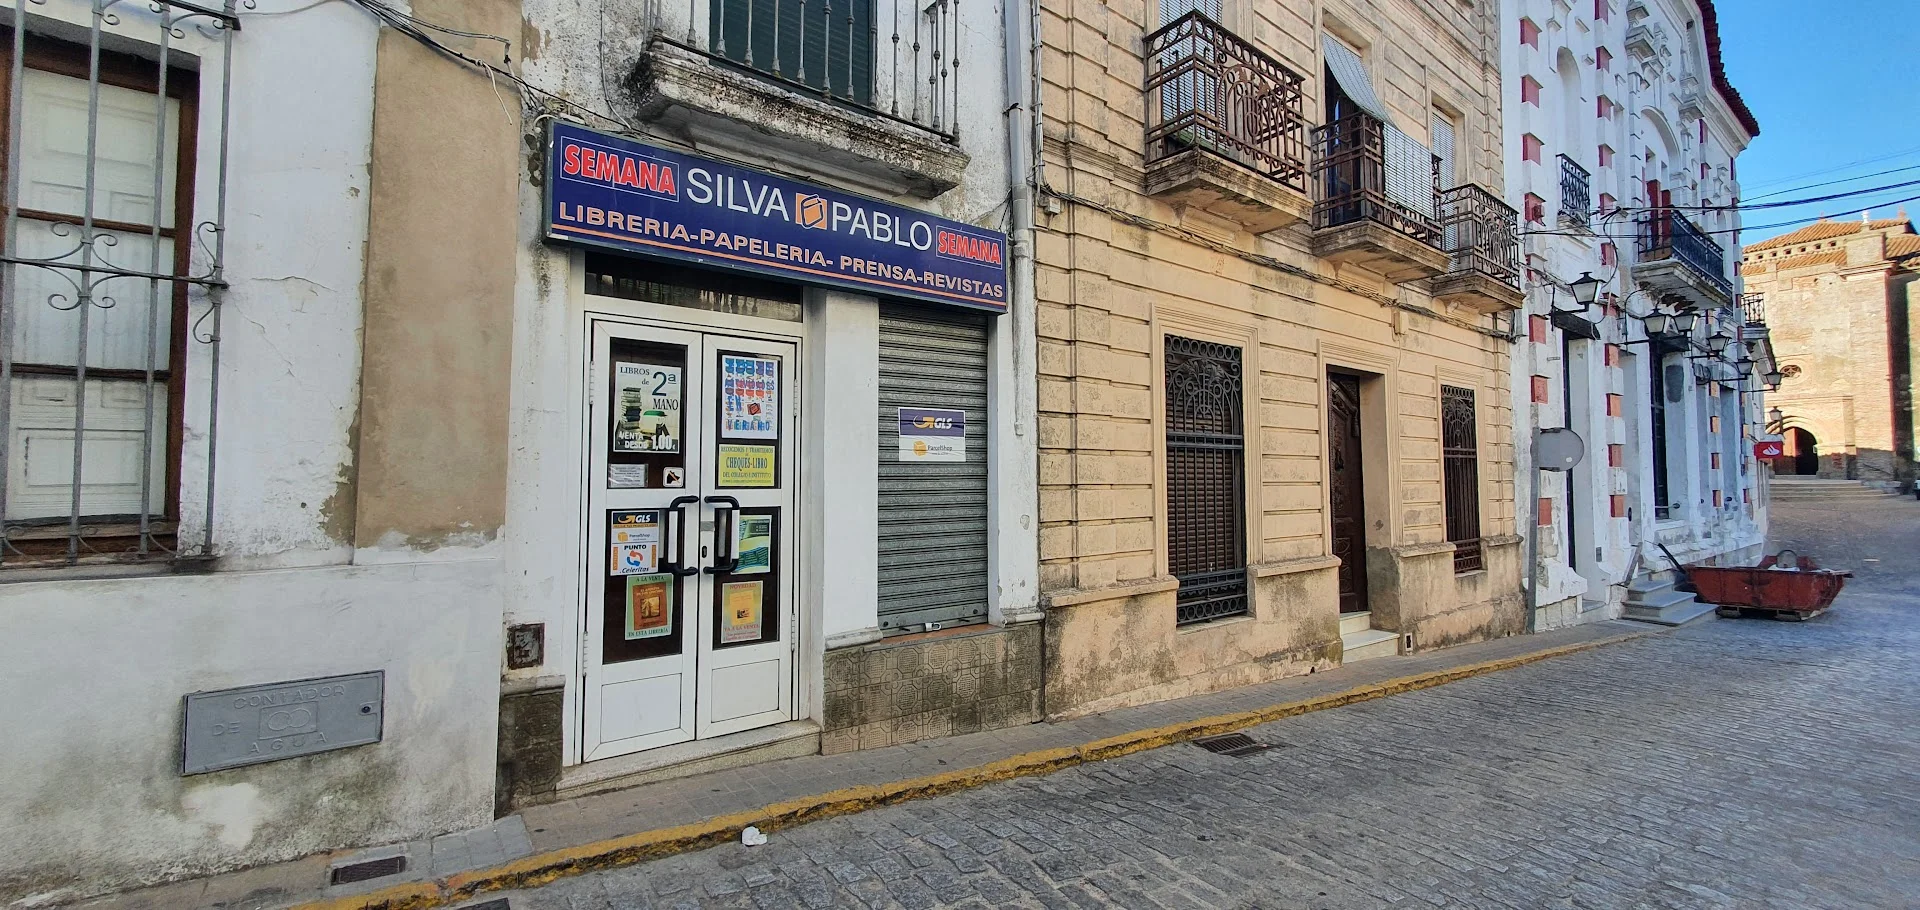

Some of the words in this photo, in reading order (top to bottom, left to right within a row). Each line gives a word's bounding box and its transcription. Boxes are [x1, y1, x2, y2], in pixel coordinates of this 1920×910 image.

[563, 143, 677, 196] SEMANA
[686, 166, 790, 222] SILVA
[831, 201, 933, 251] PABLO
[938, 230, 1002, 265] SEMANA
[620, 366, 650, 376] LIBROS
[652, 398, 679, 410] MANO
[934, 417, 953, 429] GLS
[618, 430, 644, 441] VENTA
[725, 456, 769, 472] CHEQUES-LIBRO
[635, 514, 651, 523] GLS
[233, 684, 346, 710] CONTADOR
[211, 720, 241, 737] DE
[250, 731, 329, 755] AGUA
